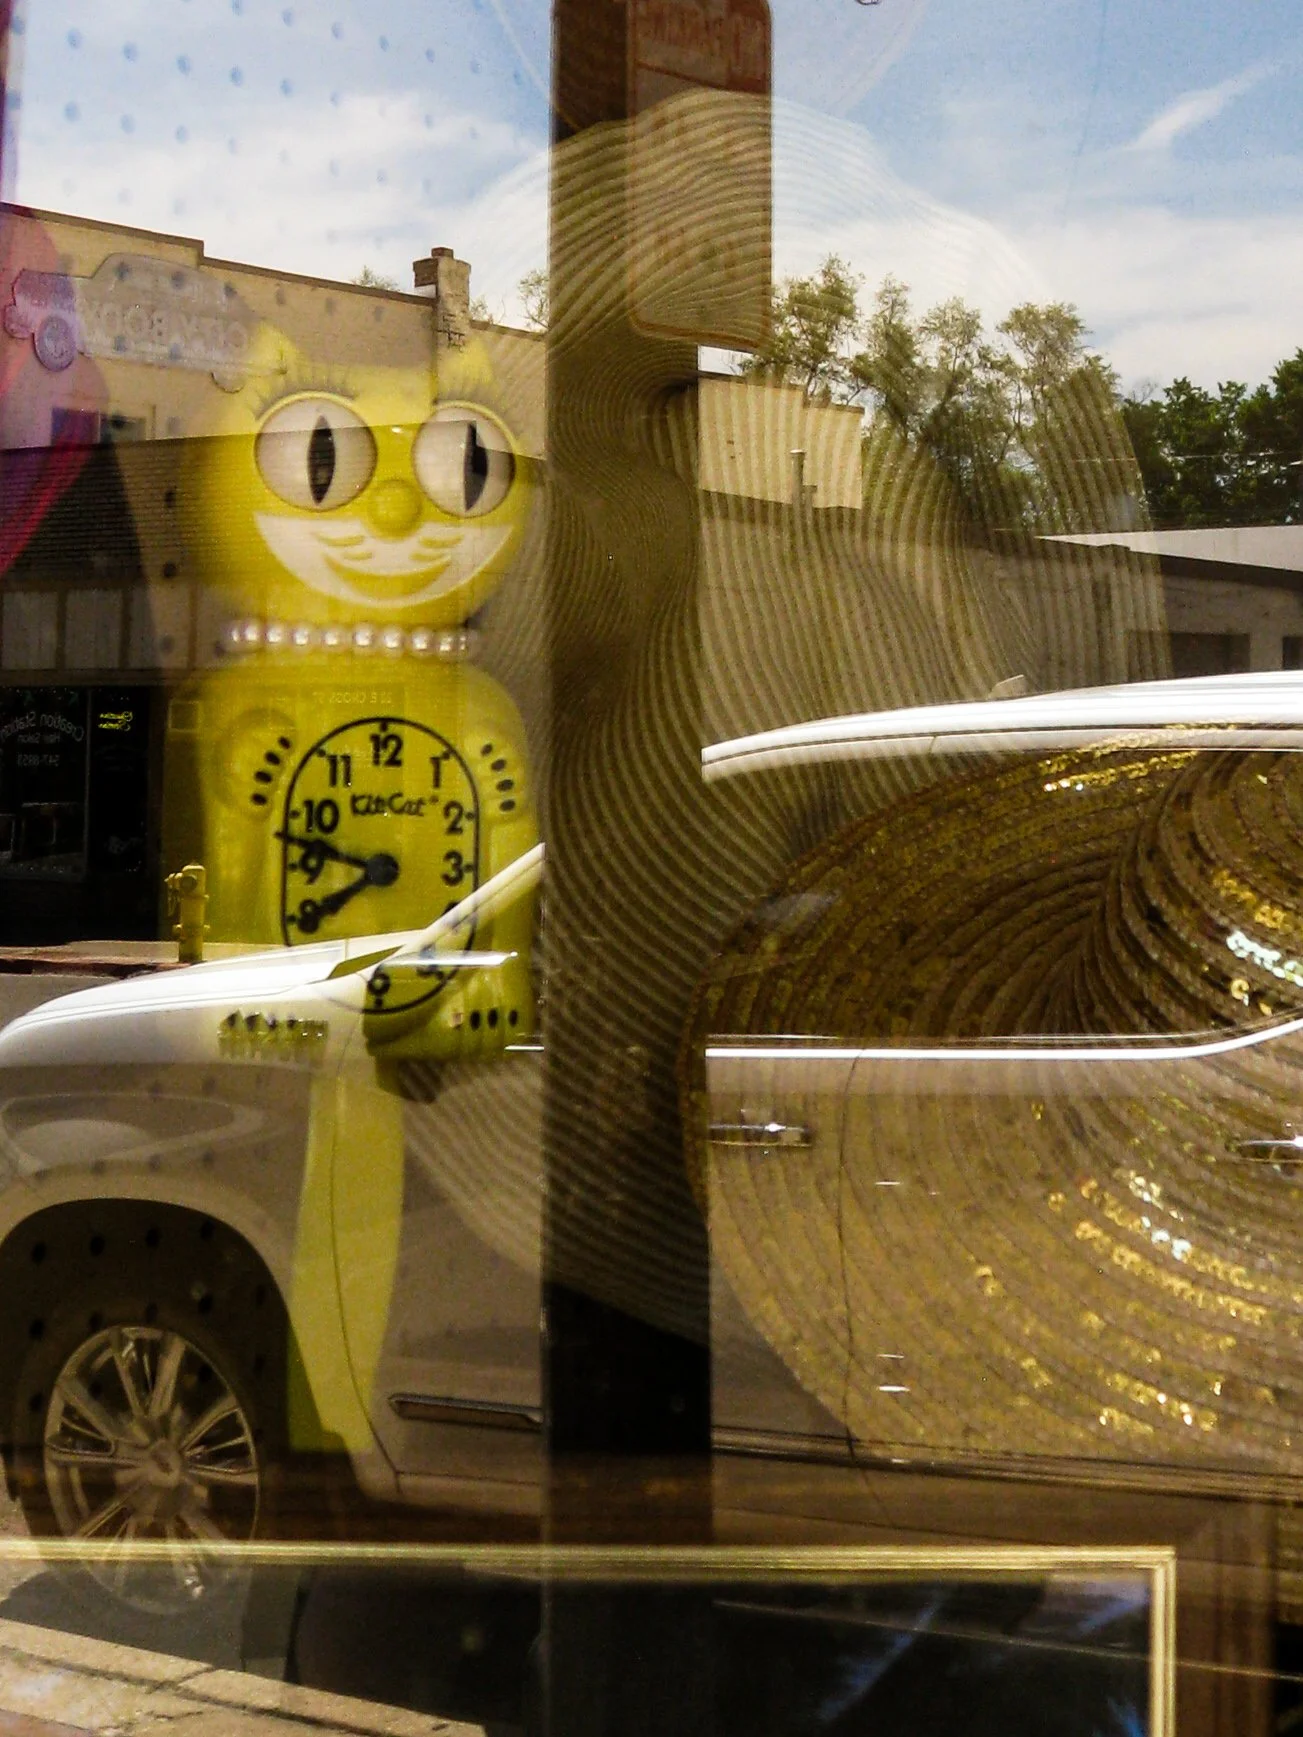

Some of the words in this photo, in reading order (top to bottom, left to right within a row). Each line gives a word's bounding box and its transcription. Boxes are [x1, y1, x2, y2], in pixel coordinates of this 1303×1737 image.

[370, 733, 403, 767] 12
[327, 754, 351, 788] 11
[430, 755, 440, 788] 1
[303, 799, 339, 834] 10
[443, 800, 464, 835] 2
[301, 846, 324, 885] 9
[440, 850, 463, 886] 3
[298, 899, 320, 934] 8
[367, 963, 392, 995] 6
